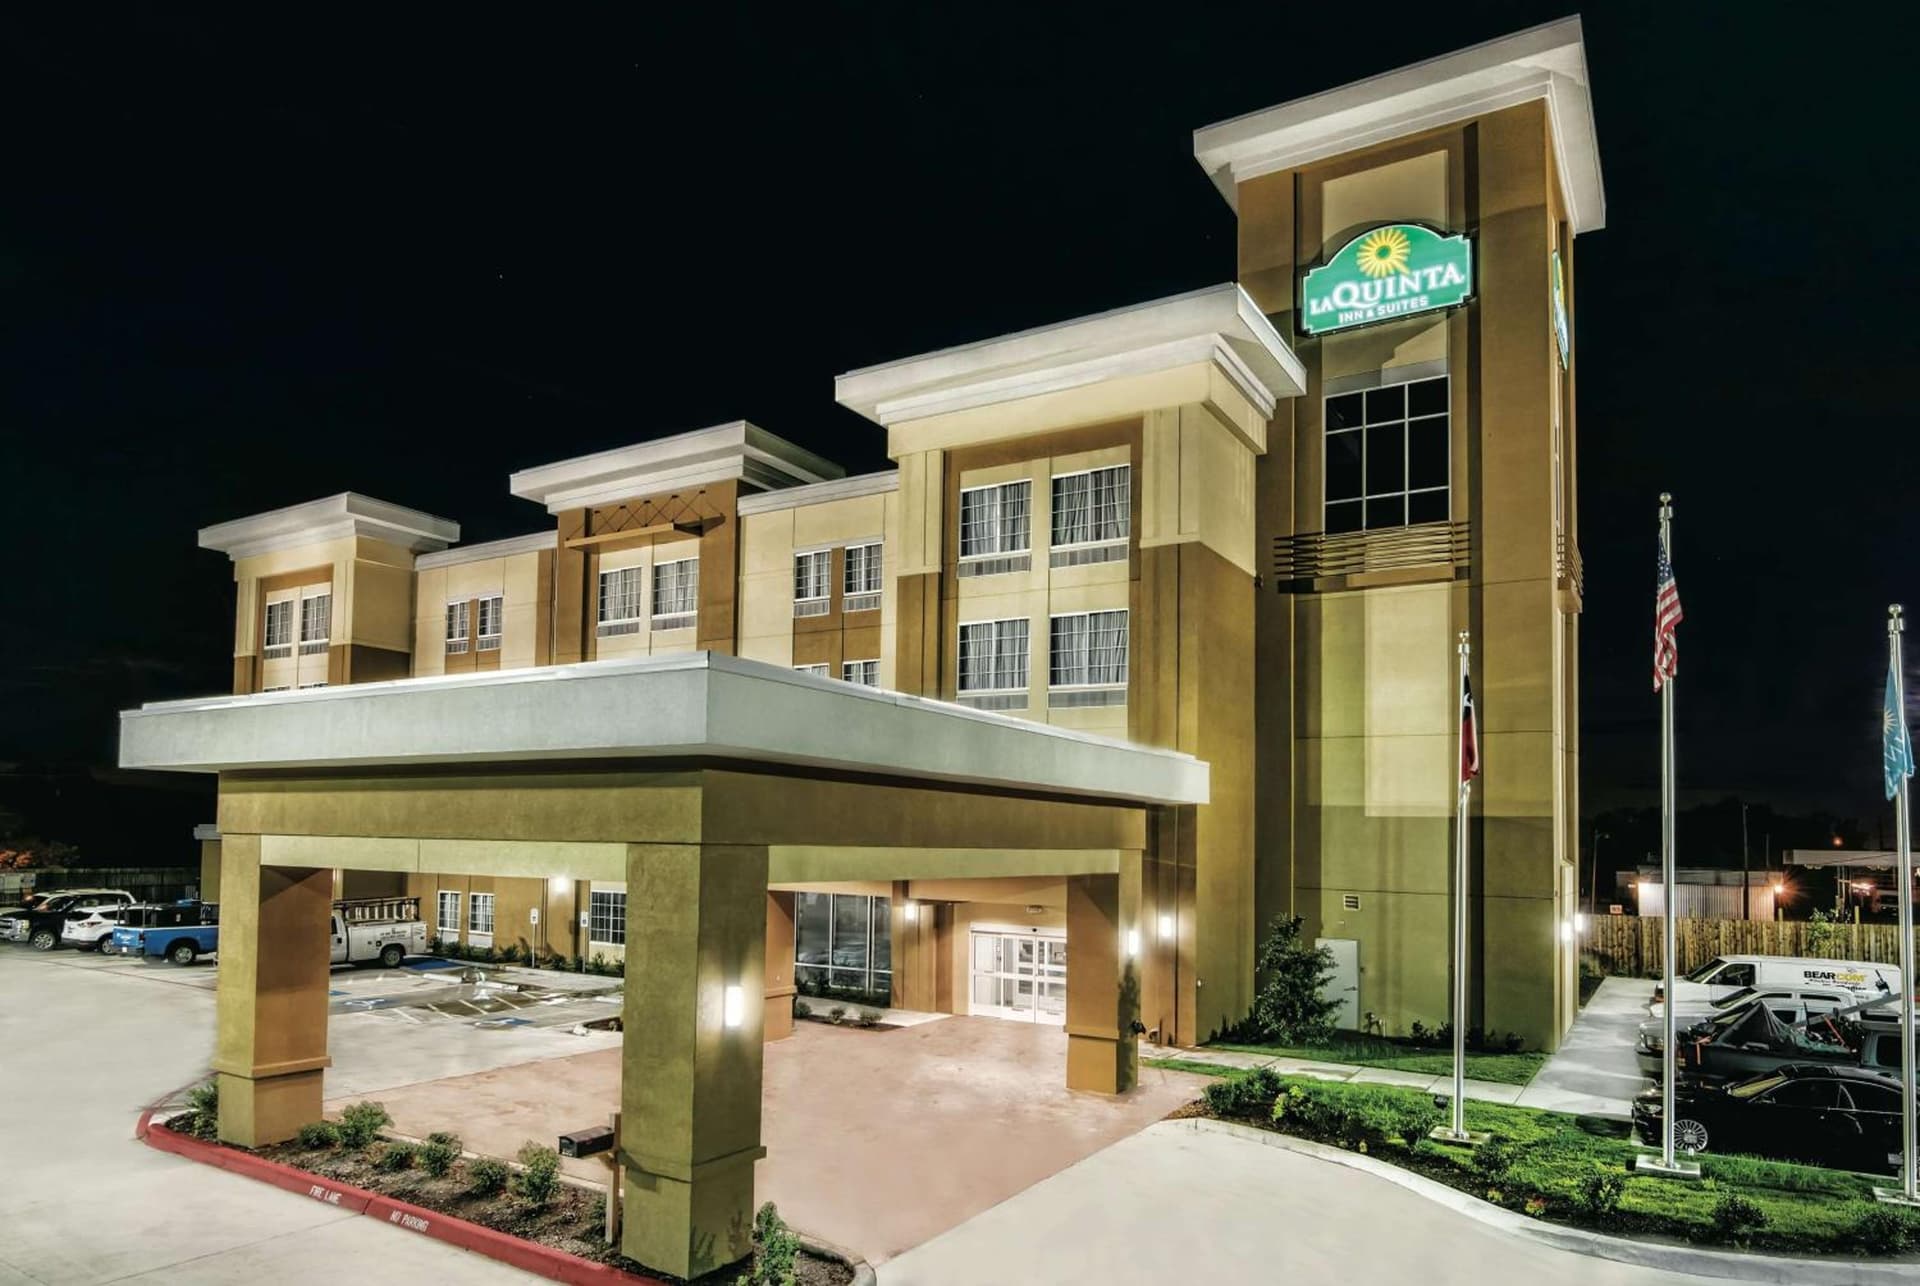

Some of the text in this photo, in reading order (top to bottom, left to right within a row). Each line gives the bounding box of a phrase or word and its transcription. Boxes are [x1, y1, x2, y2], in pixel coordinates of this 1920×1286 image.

[1310, 261, 1462, 315] LA QUINTA
[1338, 295, 1429, 324] INN & SUITES
[309, 1184, 343, 1205] FIRE LANE
[390, 1210, 430, 1232] NO PARKING
